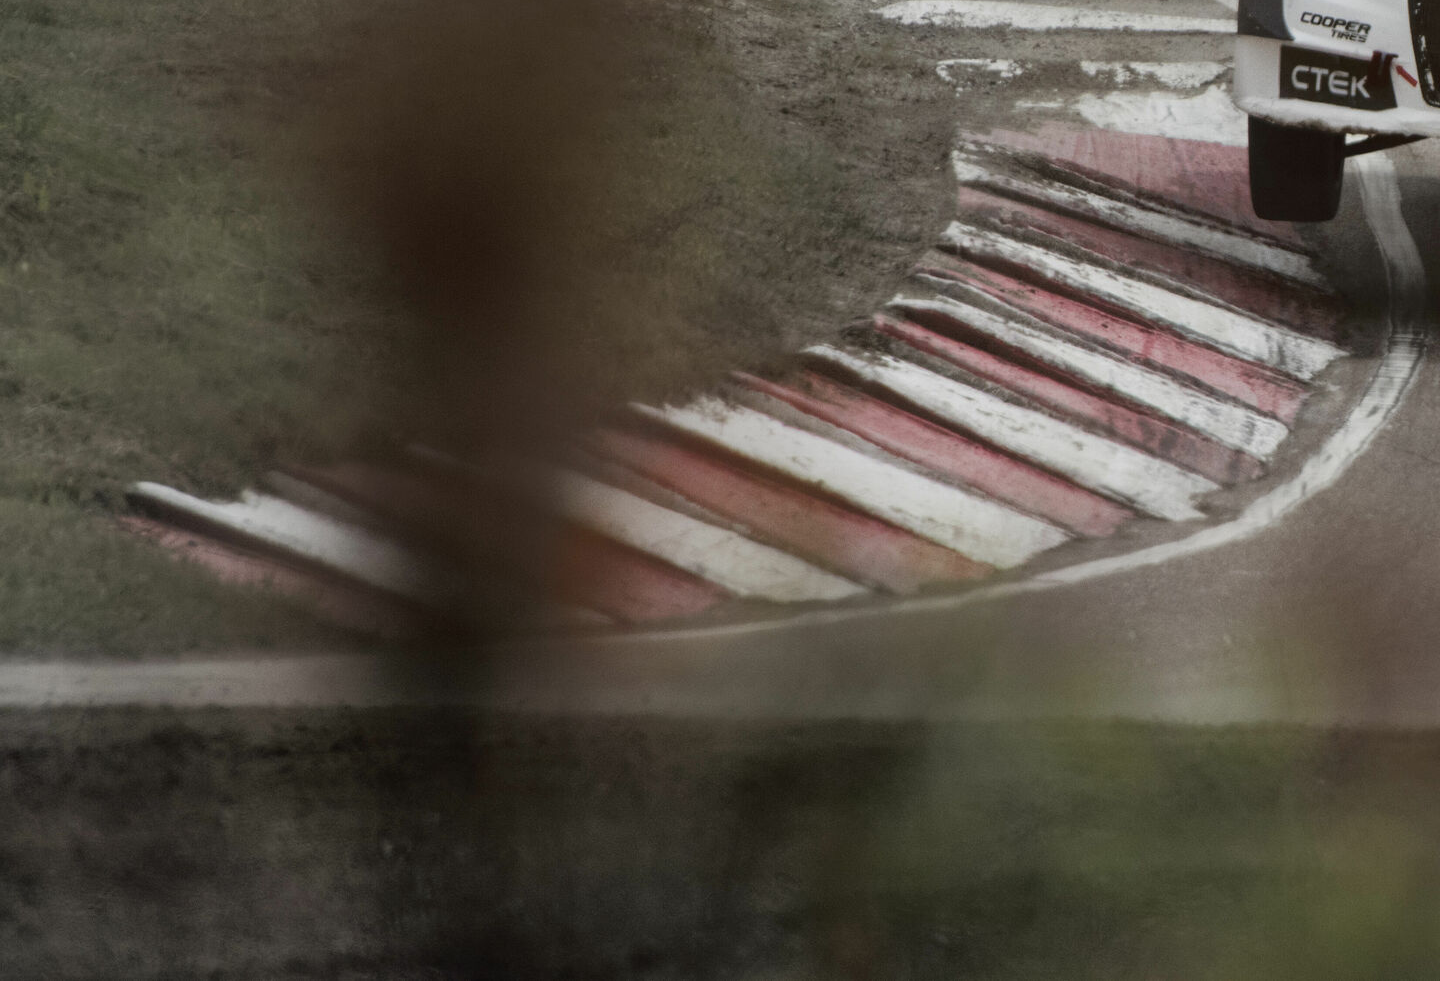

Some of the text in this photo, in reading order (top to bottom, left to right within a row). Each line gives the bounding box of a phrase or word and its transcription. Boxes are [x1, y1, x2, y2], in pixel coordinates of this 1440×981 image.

[1300, 11, 1371, 34] COOPER
[1331, 30, 1369, 43] TIRES
[1291, 64, 1371, 98] CTEK
